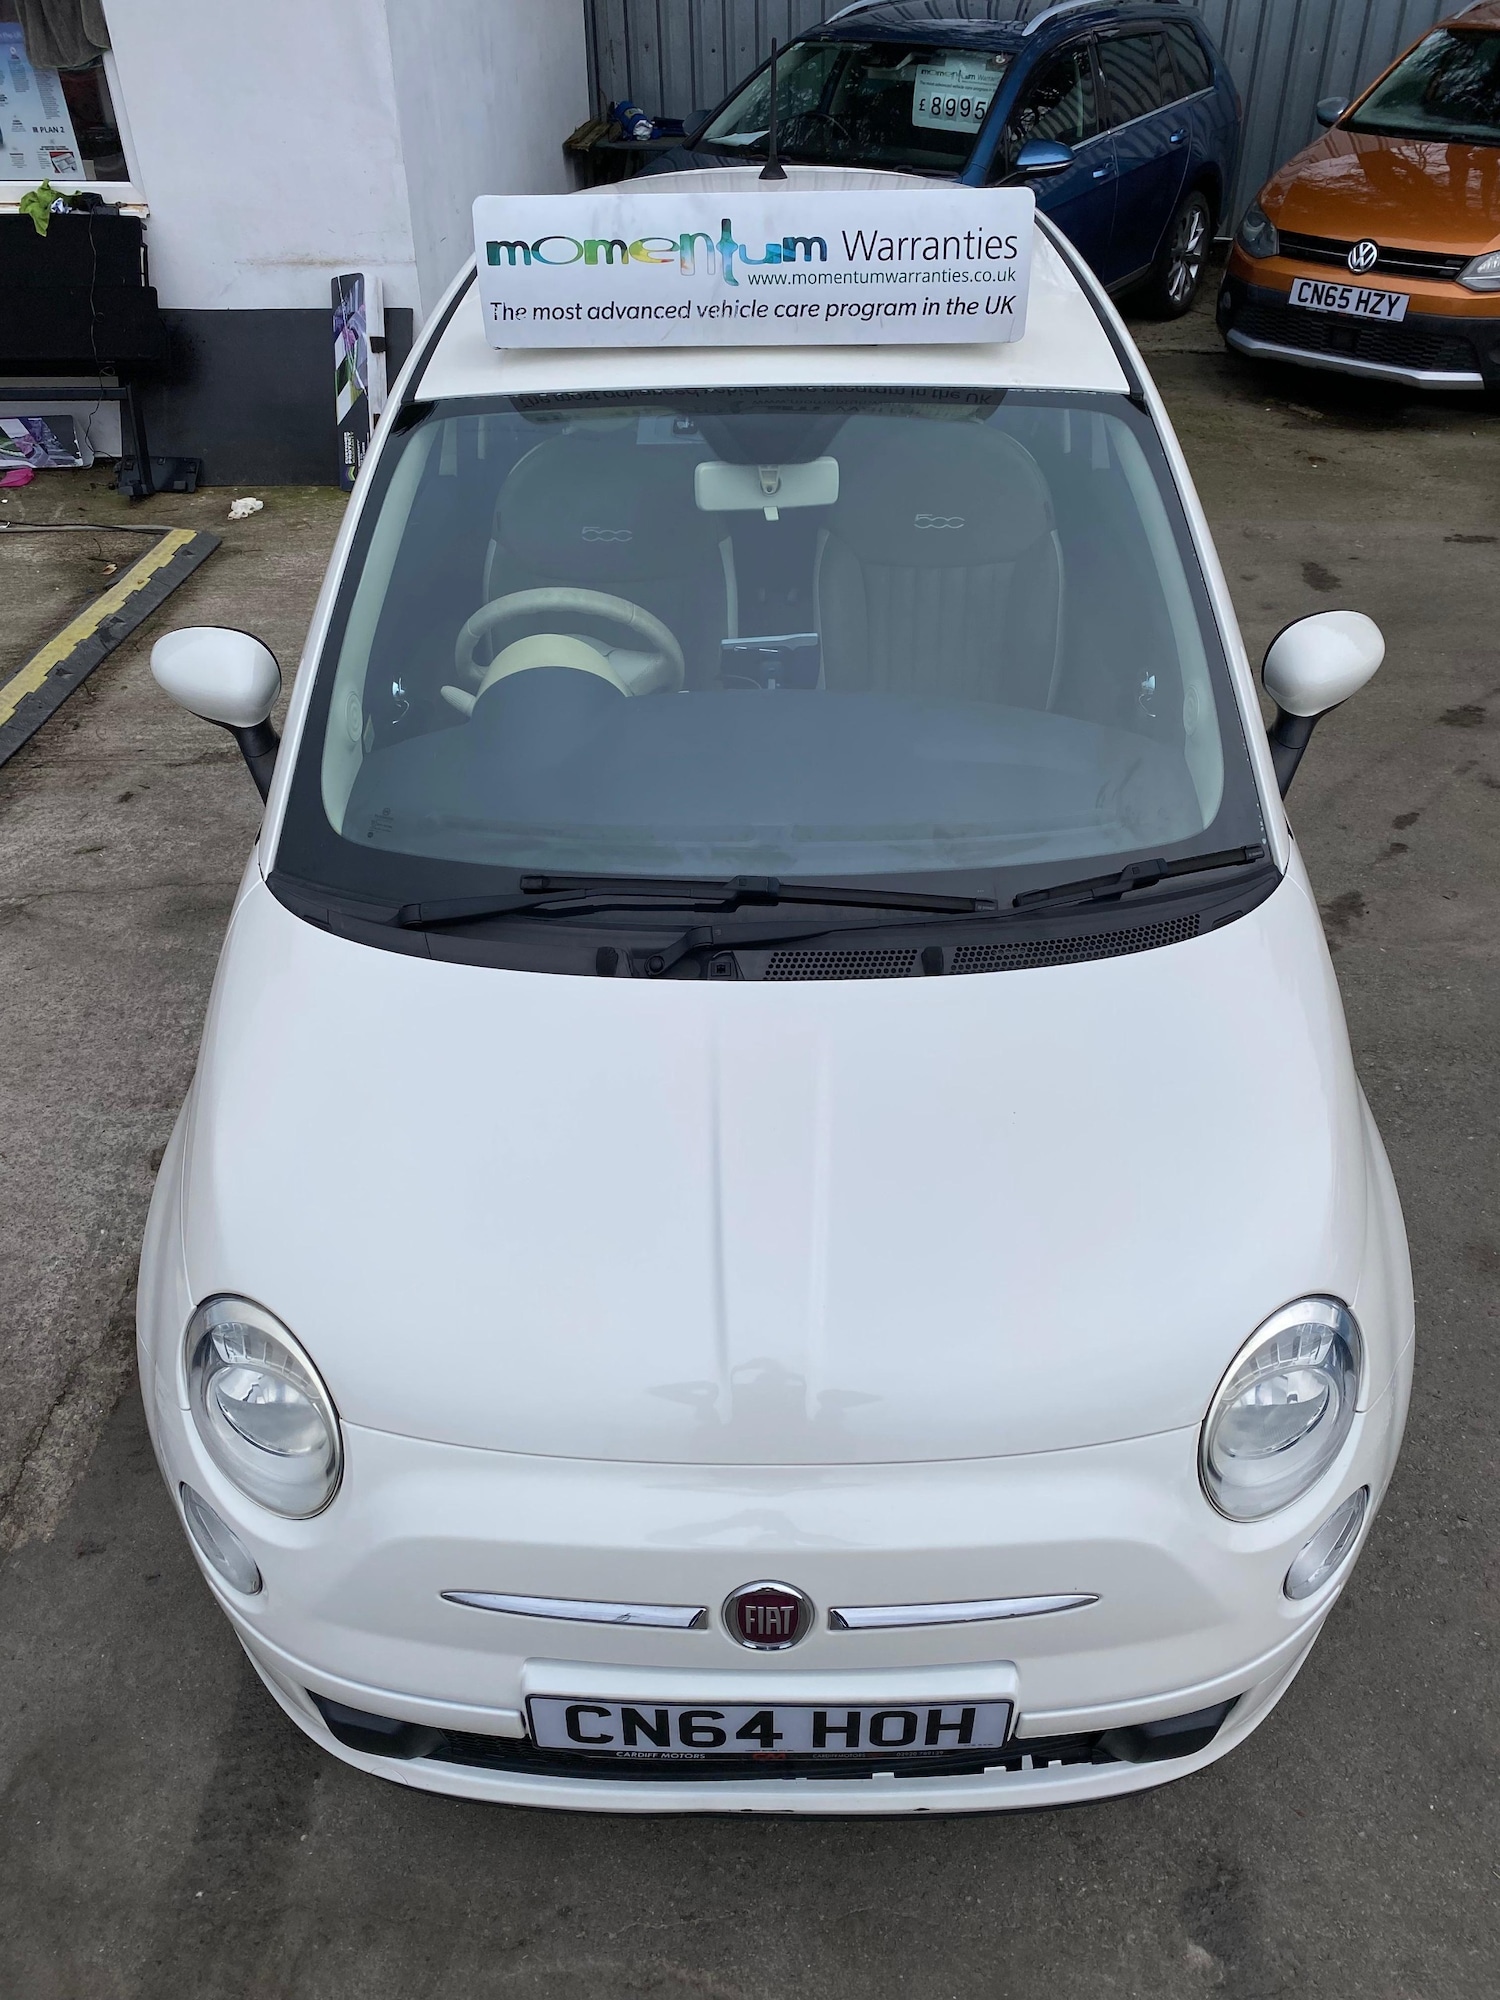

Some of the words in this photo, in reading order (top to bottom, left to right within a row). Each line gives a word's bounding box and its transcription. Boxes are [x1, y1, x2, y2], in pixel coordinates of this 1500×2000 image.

[931, 97, 986, 119] 8995
[486, 218, 828, 287] momentum
[842, 227, 1018, 262] Warranties
[748, 266, 1016, 285] www.momentumwarranties.co.uk
[490, 302, 527, 321] The
[533, 303, 582, 321] most
[587, 300, 691, 320] advanced
[696, 299, 769, 319] vehicle
[774, 303, 820, 318] care
[825, 301, 917, 321] program
[922, 297, 940, 316] in
[946, 296, 979, 315] the
[985, 295, 1016, 314] UK
[1298, 282, 1353, 309] CN65
[1355, 290, 1400, 317] HZY
[745, 1605, 794, 1635] FIAT
[564, 1704, 782, 1748] CN64
[812, 1707, 976, 1747] HOH
[616, 1751, 658, 1759] CARDIFF
